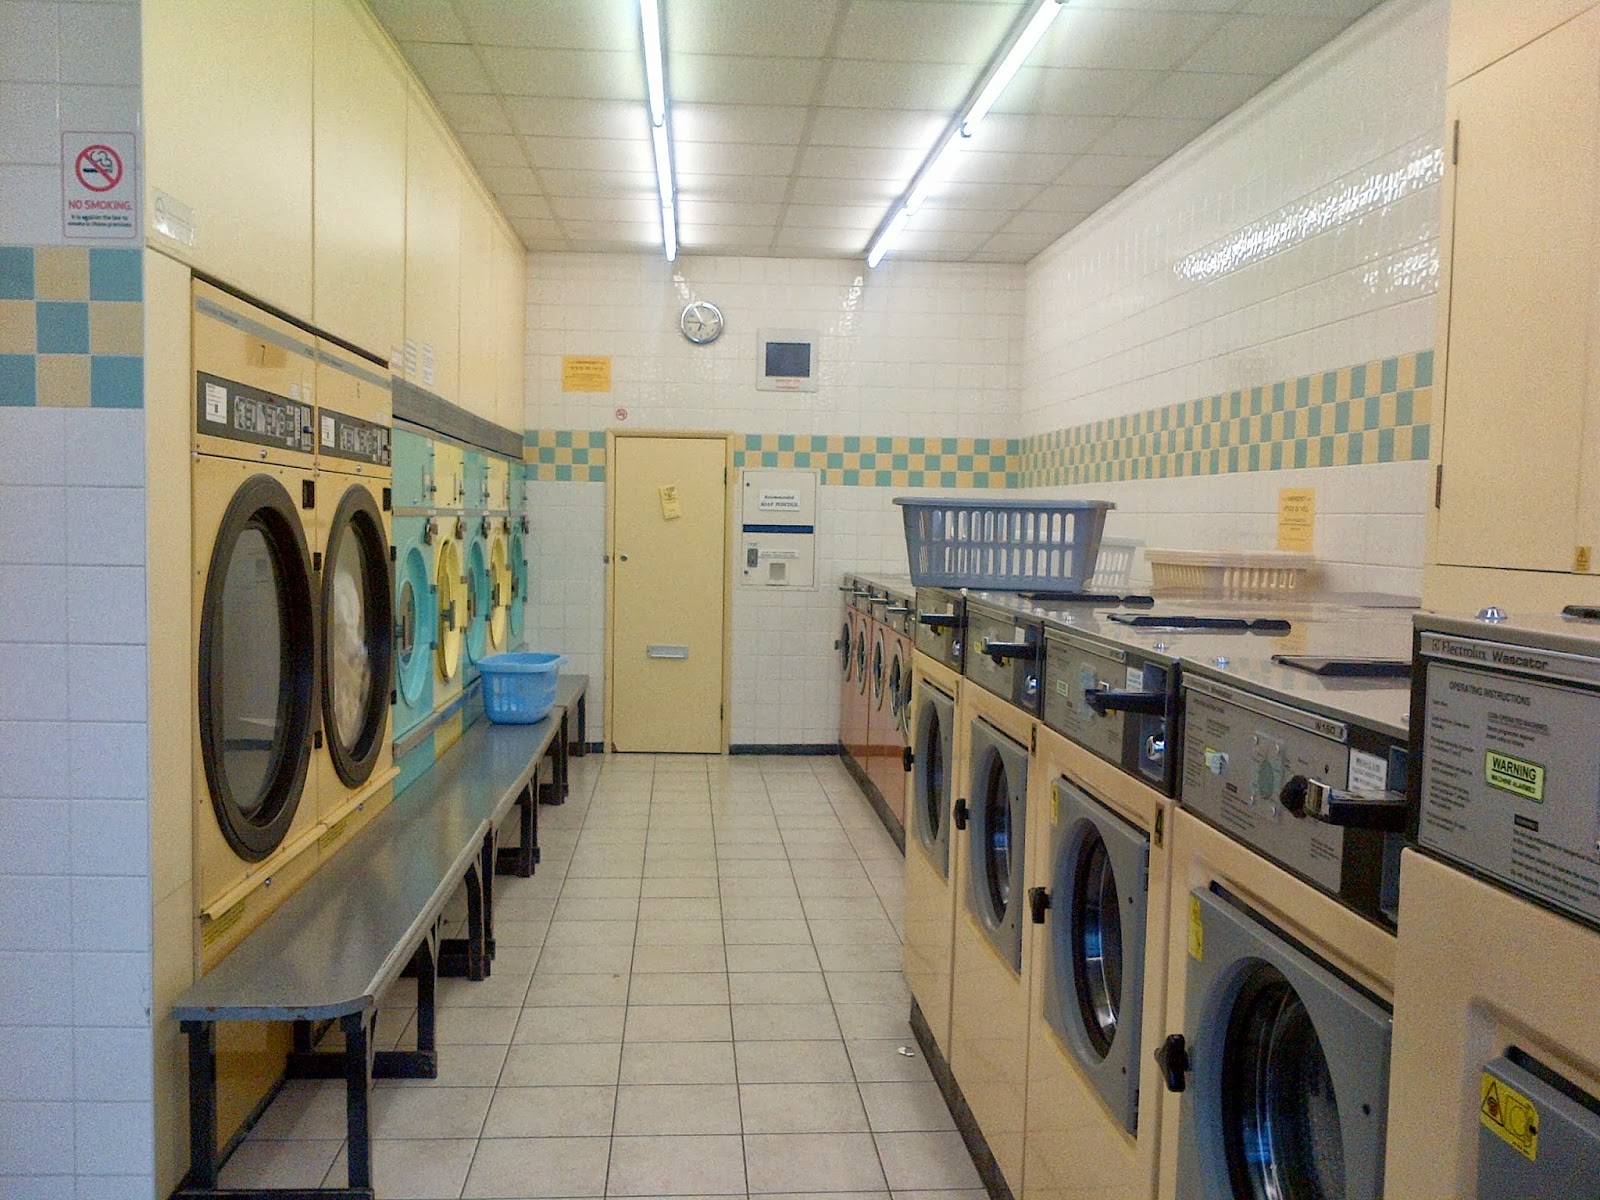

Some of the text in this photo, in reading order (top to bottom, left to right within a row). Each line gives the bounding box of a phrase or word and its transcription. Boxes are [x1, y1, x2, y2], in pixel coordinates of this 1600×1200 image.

[68, 199, 82, 209] NO
[1442, 641, 1549, 669] Electrolux Wascator
[1448, 681, 1531, 706] OPERATING INSTRUCTIONS
[1493, 756, 1537, 780] WARNING
[1155, 808, 1164, 843] 4
